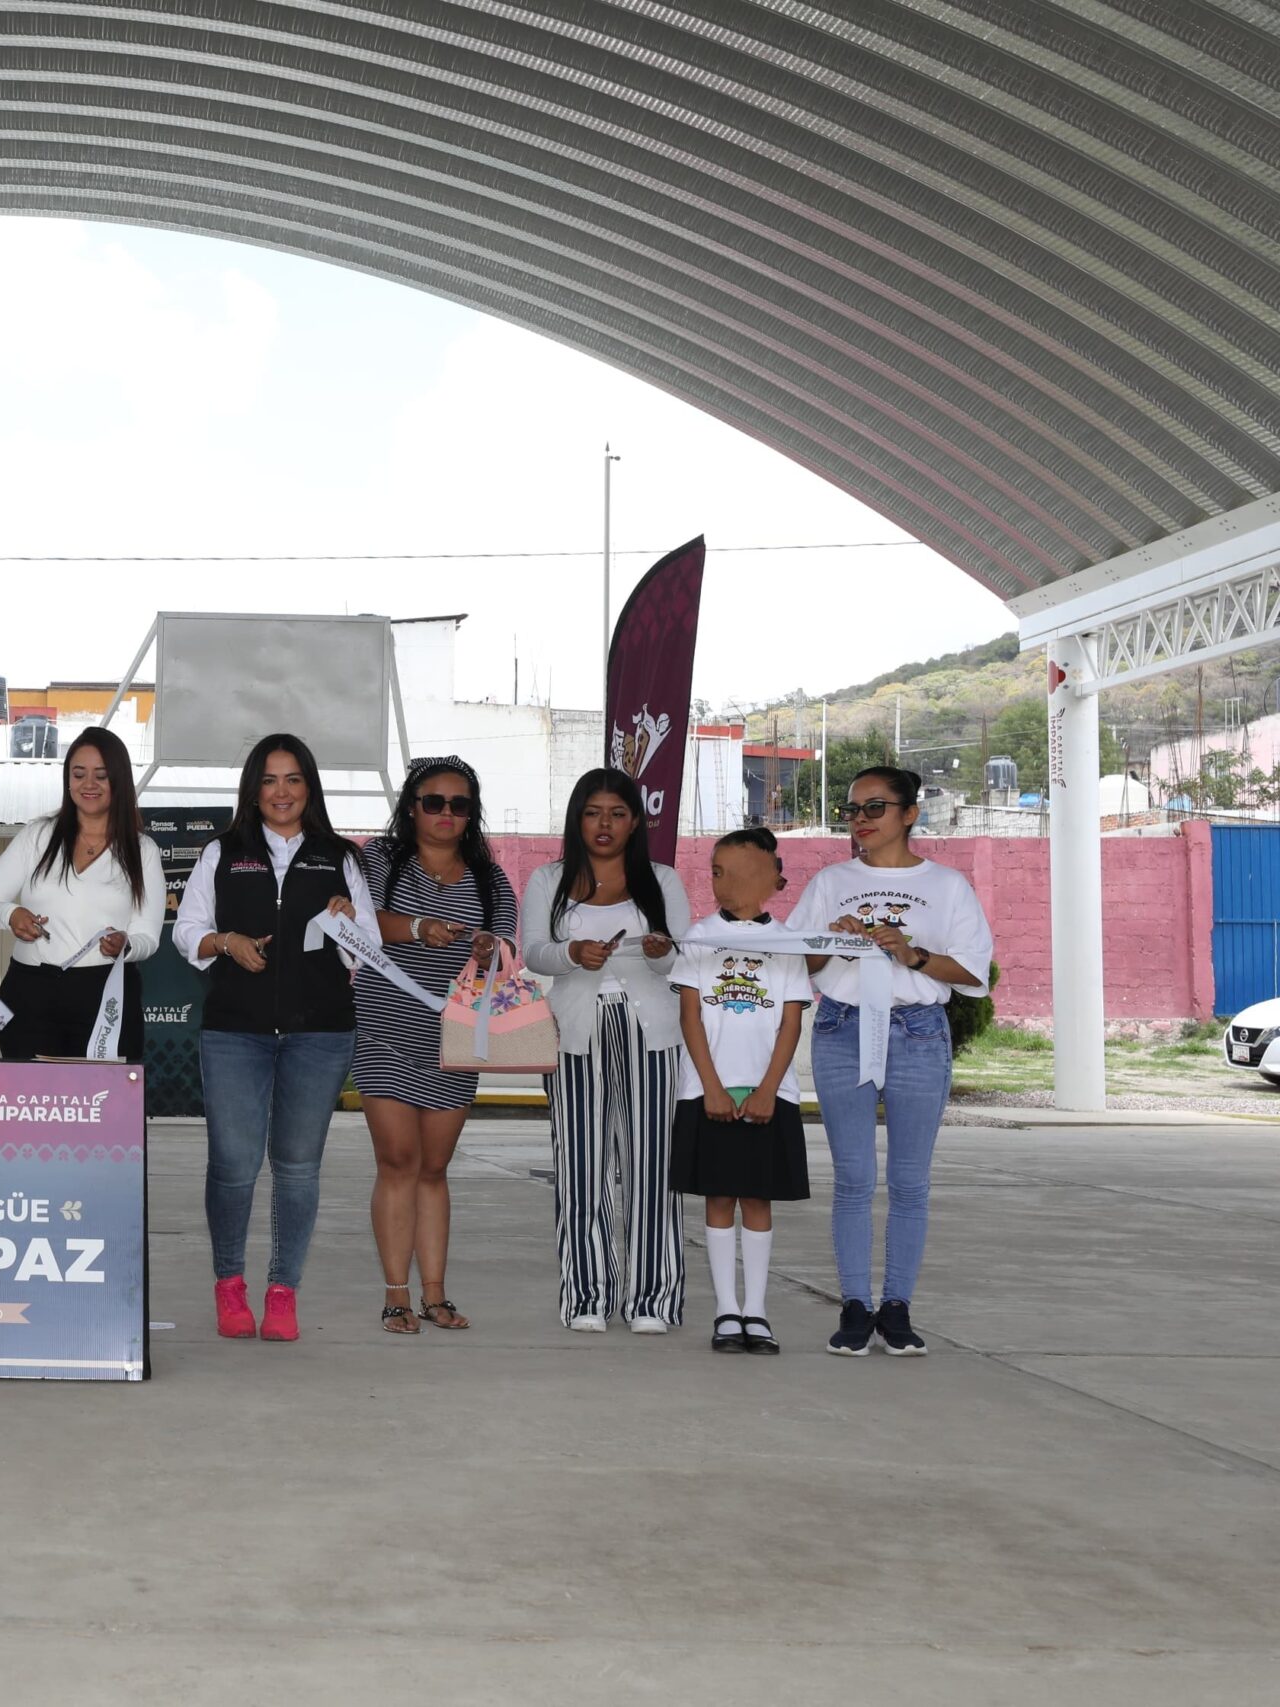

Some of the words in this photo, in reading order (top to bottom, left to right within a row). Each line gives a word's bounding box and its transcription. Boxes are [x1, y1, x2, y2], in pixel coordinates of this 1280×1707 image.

[840, 896, 859, 906] LOS
[861, 891, 928, 906] IMPARABLES
[338, 931, 389, 970] IMPARABLE
[718, 993, 734, 1002] DEL
[736, 993, 762, 1006] AGUA
[17, 1095, 90, 1106] CAPITAL
